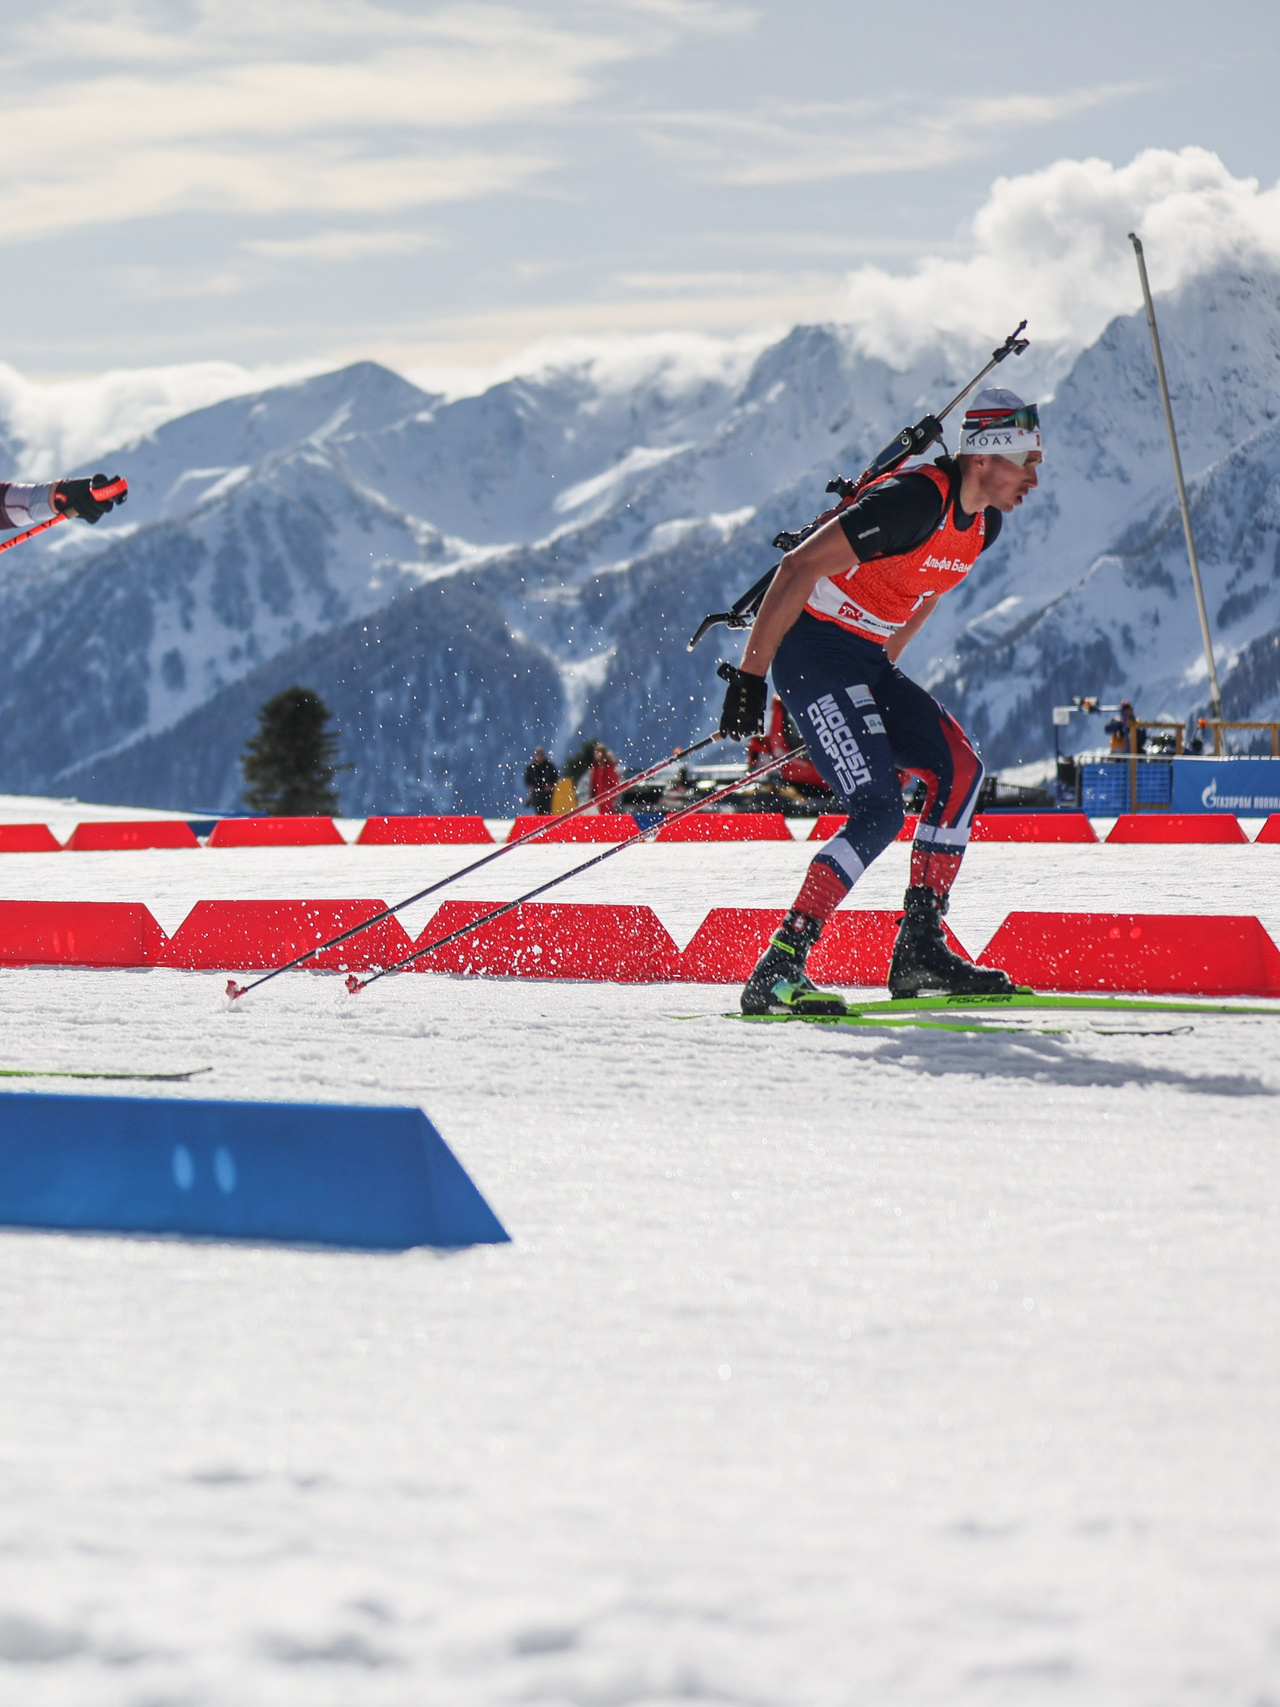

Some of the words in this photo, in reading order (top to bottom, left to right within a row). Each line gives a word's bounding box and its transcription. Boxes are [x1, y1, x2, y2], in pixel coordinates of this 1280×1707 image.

[919, 554, 951, 572] Альфа
[807, 702, 848, 772] СПОРТ
[946, 995, 1012, 1004] FISCHER
